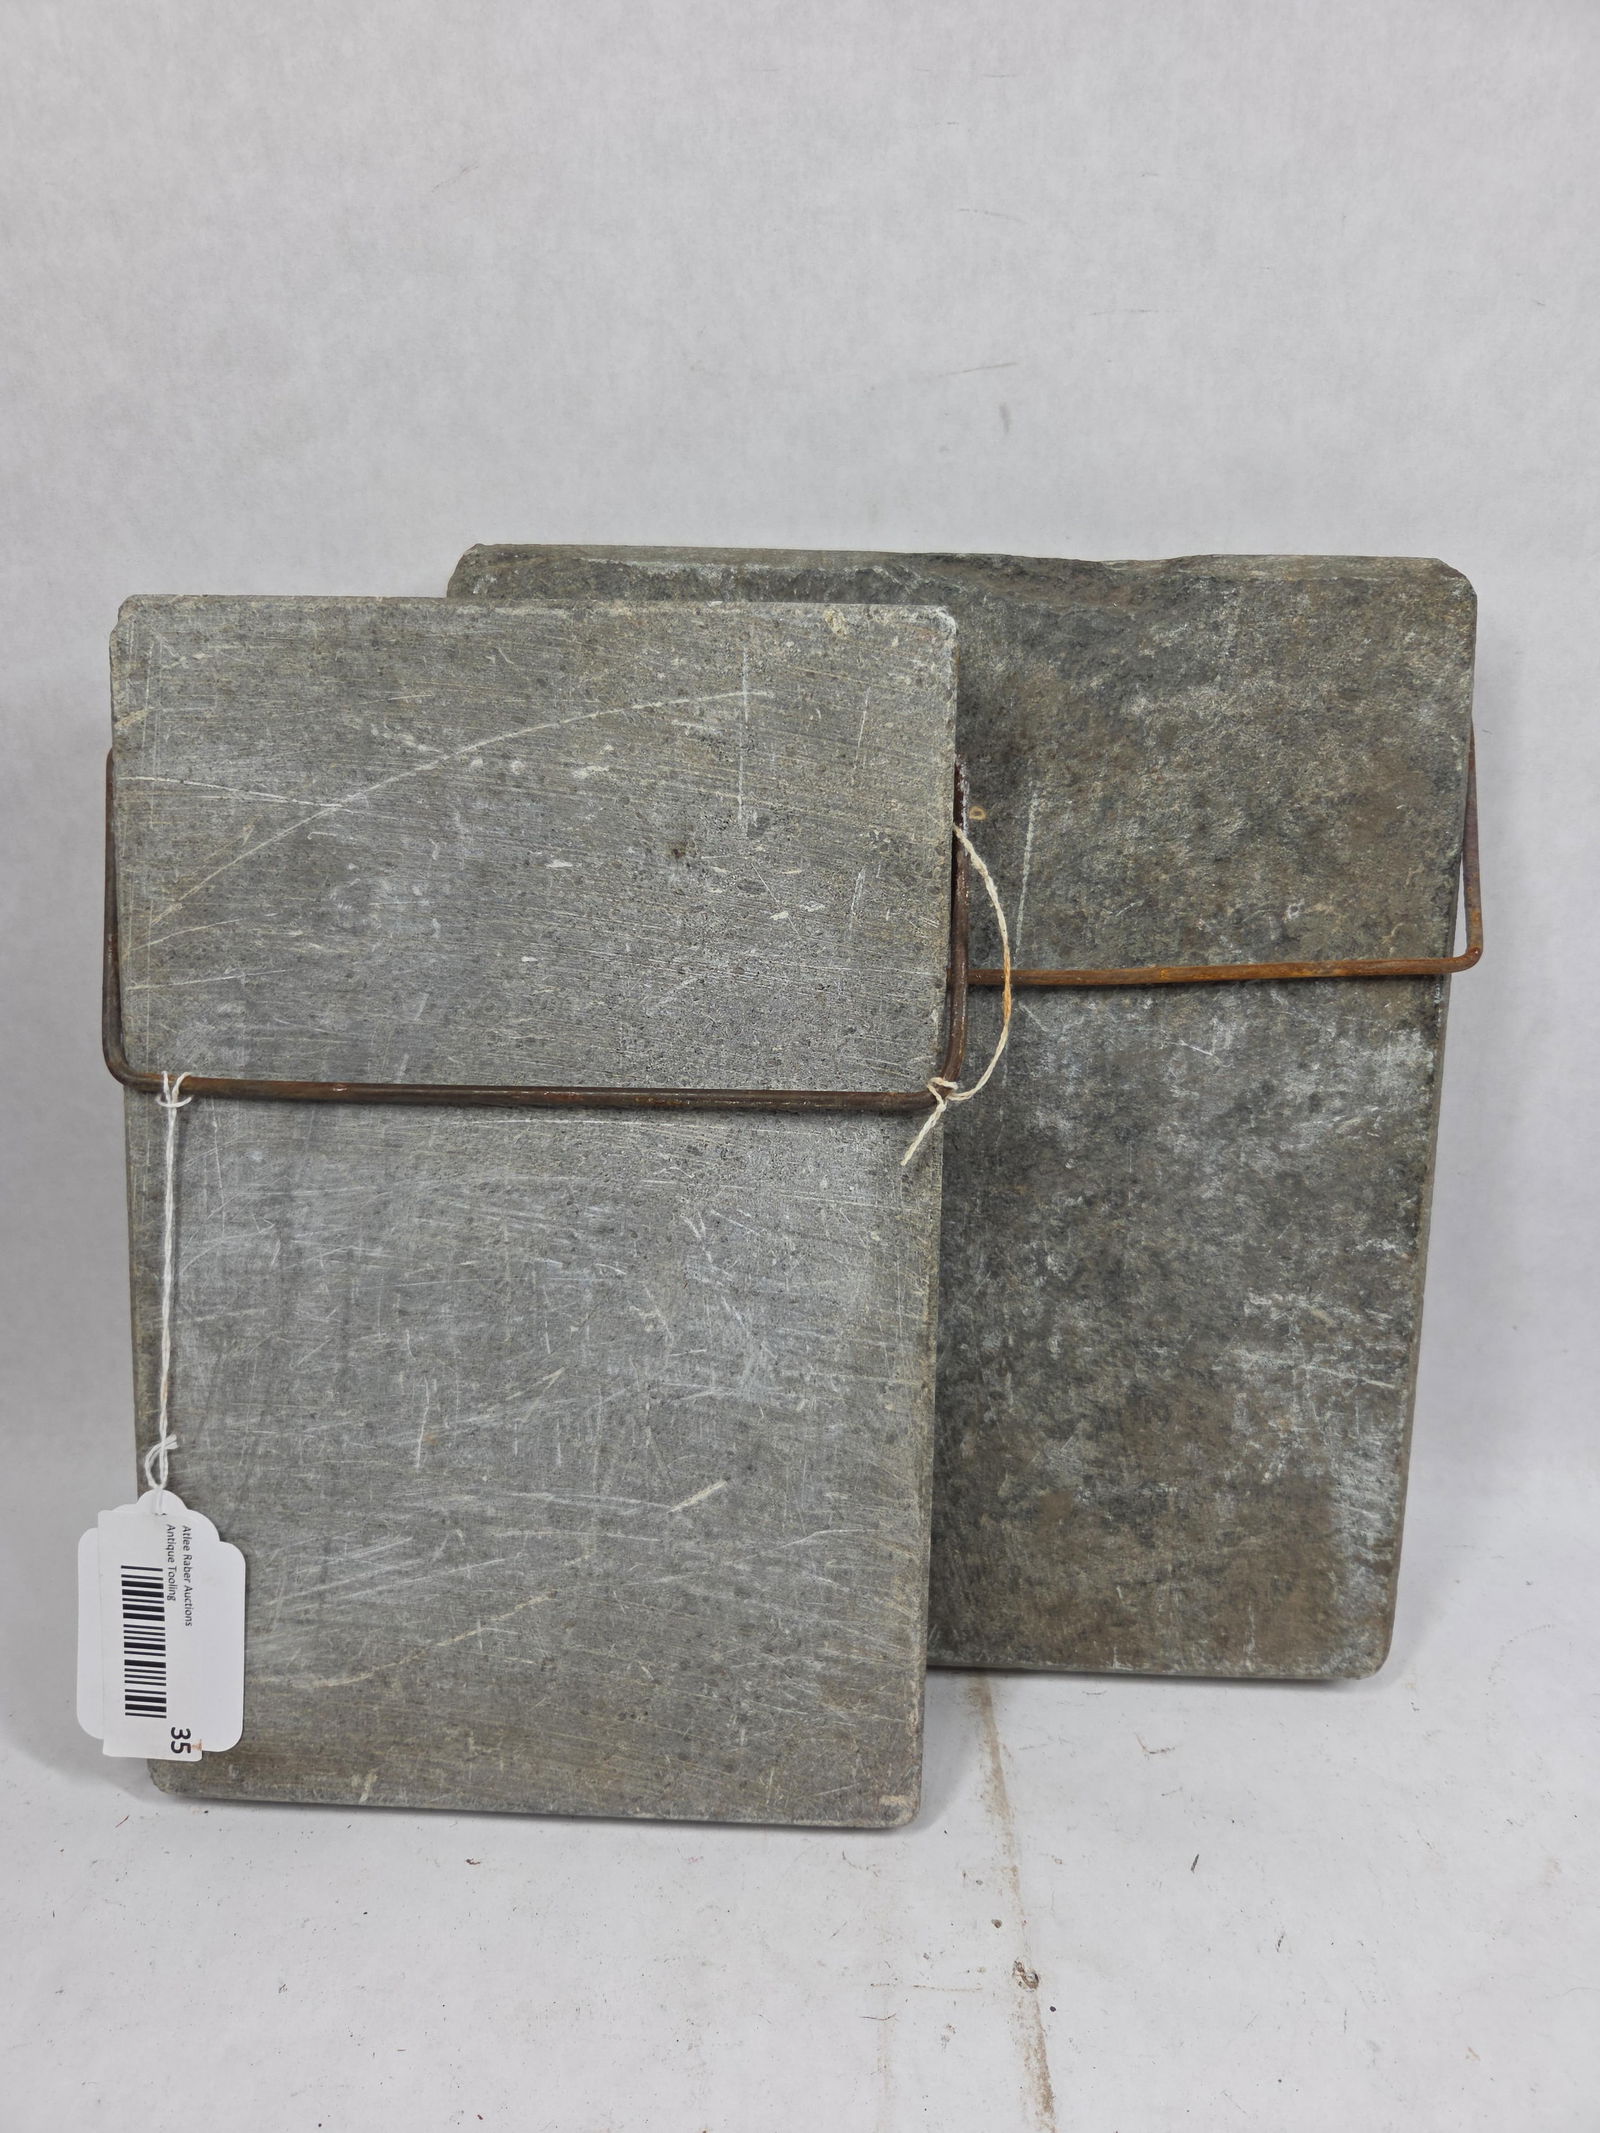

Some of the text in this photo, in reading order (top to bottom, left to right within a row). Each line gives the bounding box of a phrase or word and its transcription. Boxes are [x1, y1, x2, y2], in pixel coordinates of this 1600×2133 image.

[166, 1524, 178, 1601] Antique Tooling
[182, 1525, 194, 1627] Atlee Raber Auctions
[170, 1726, 191, 1754] 35
